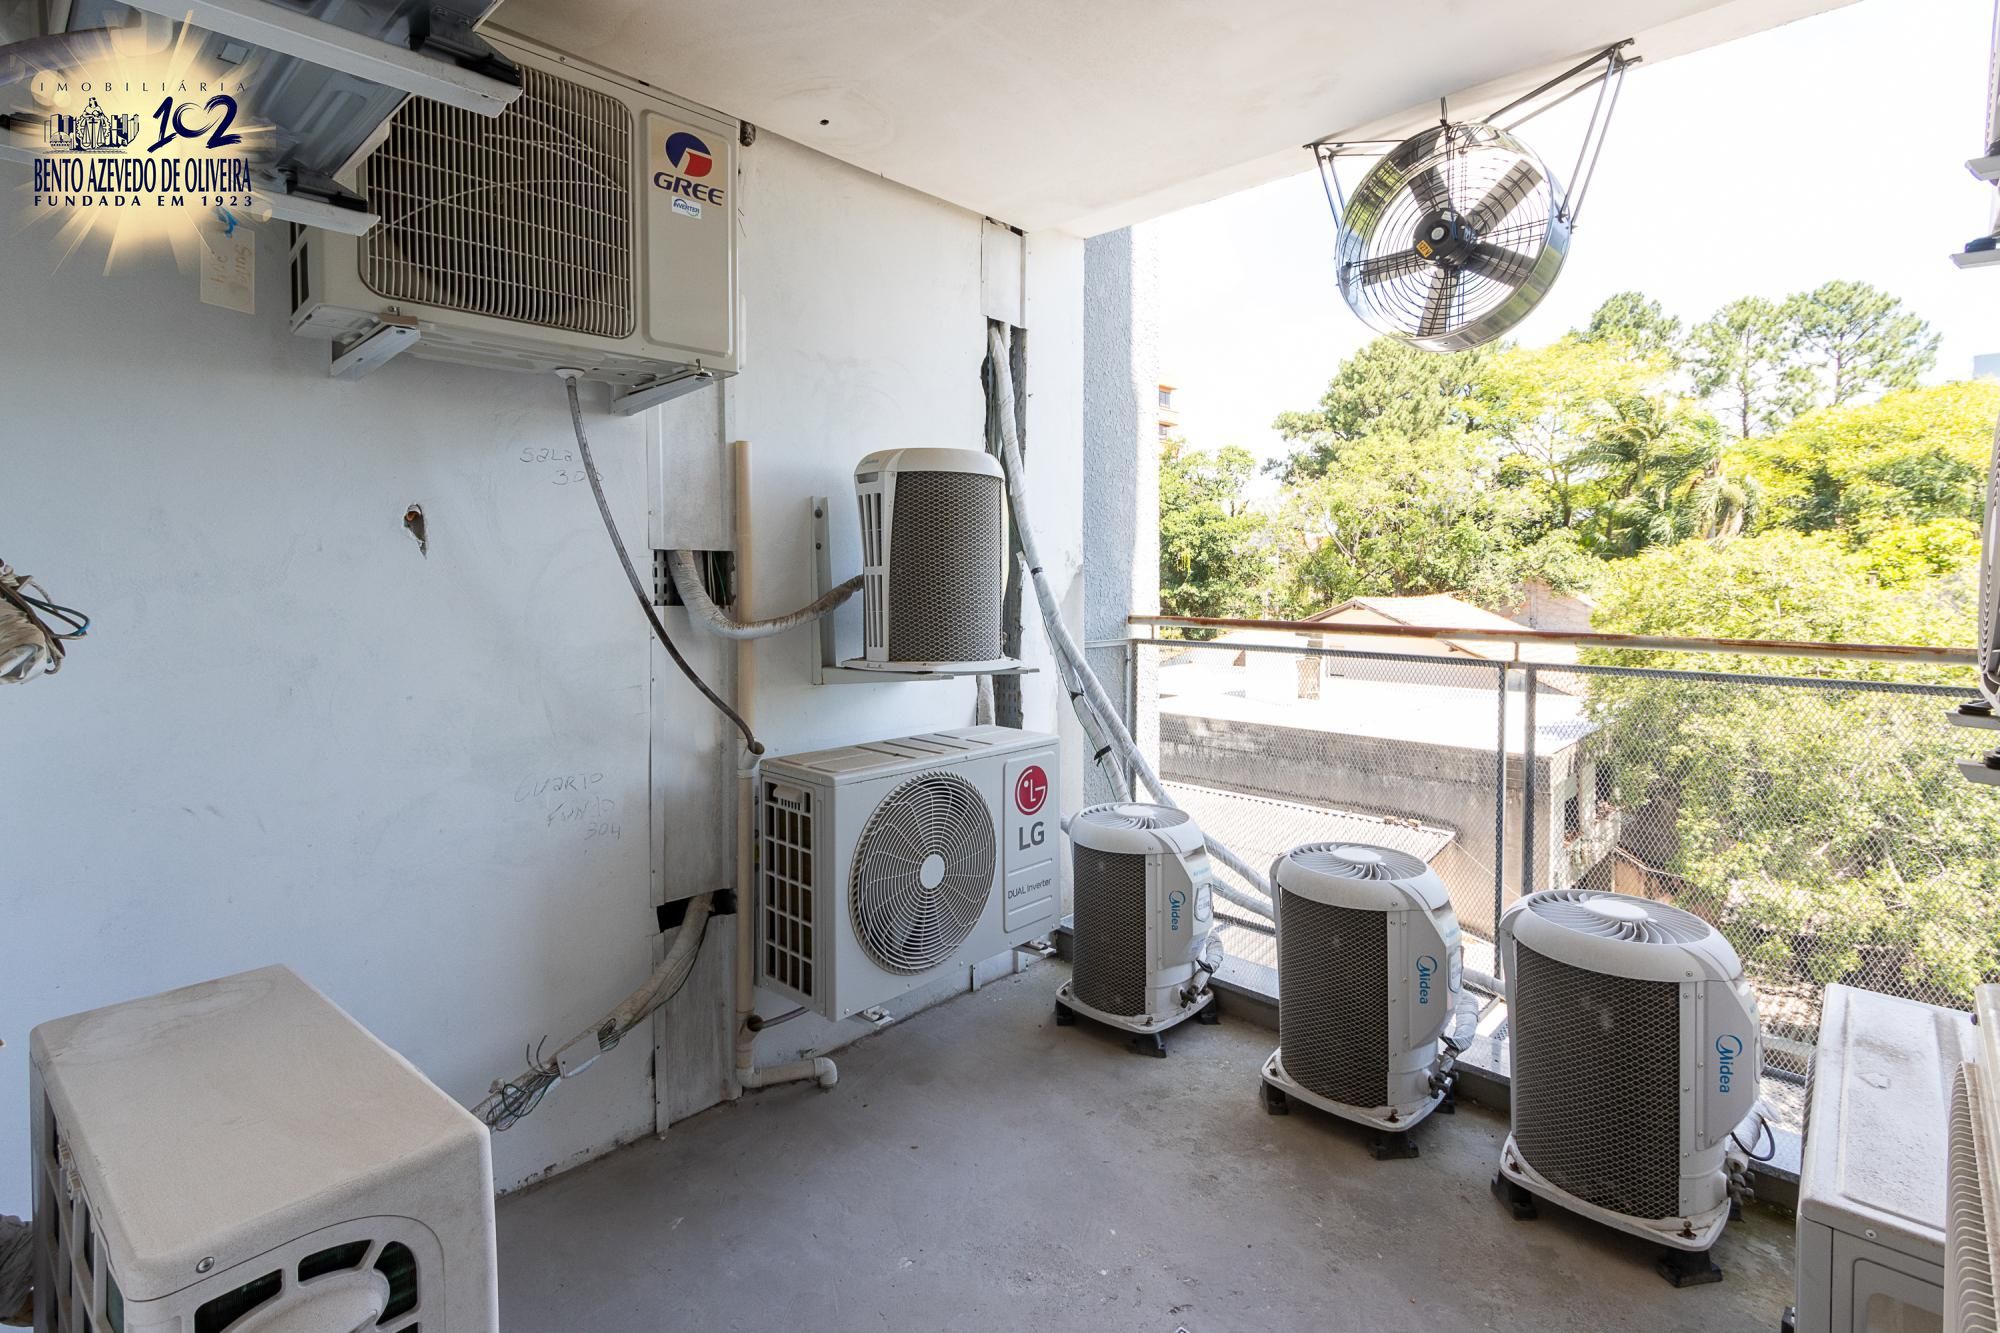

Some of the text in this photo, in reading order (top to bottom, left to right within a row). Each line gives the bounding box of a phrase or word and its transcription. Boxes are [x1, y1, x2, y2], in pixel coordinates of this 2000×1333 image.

[653, 171, 725, 207] GREE
[1018, 821, 1045, 851] LG
[1007, 878, 1052, 899] DUAL Inverter
[1168, 890, 1185, 931] Midea
[1416, 955, 1437, 1004] Midea
[1716, 1034, 1743, 1093] Midea
